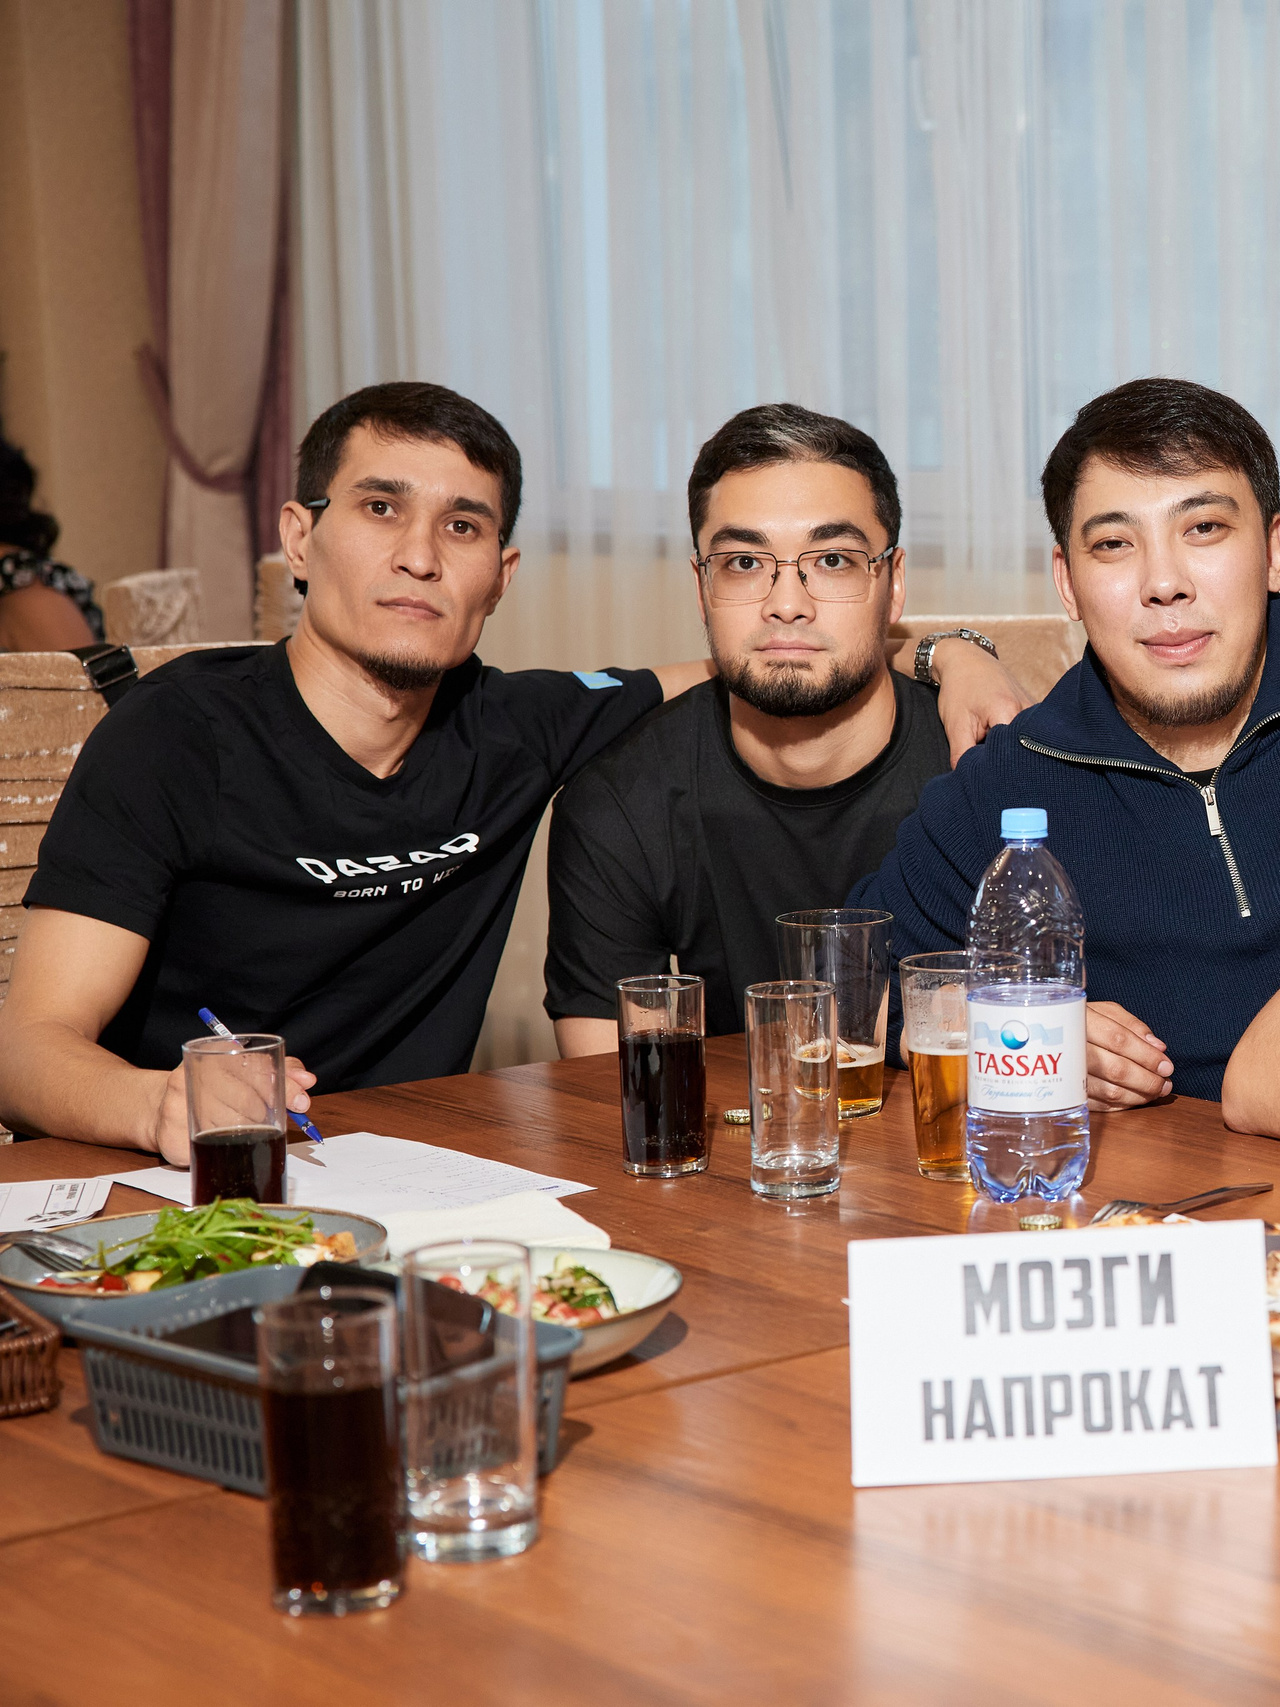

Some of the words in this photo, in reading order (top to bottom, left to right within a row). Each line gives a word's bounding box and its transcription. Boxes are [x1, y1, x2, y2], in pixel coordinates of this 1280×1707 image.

[296, 833, 480, 884] QAZAQ
[333, 885, 388, 898] BORN
[400, 877, 424, 893] TO
[974, 1051, 1063, 1077] TASSAY
[962, 1252, 1176, 1336] МОЗГИ
[921, 1365, 1224, 1442] НАПРОКАТ
